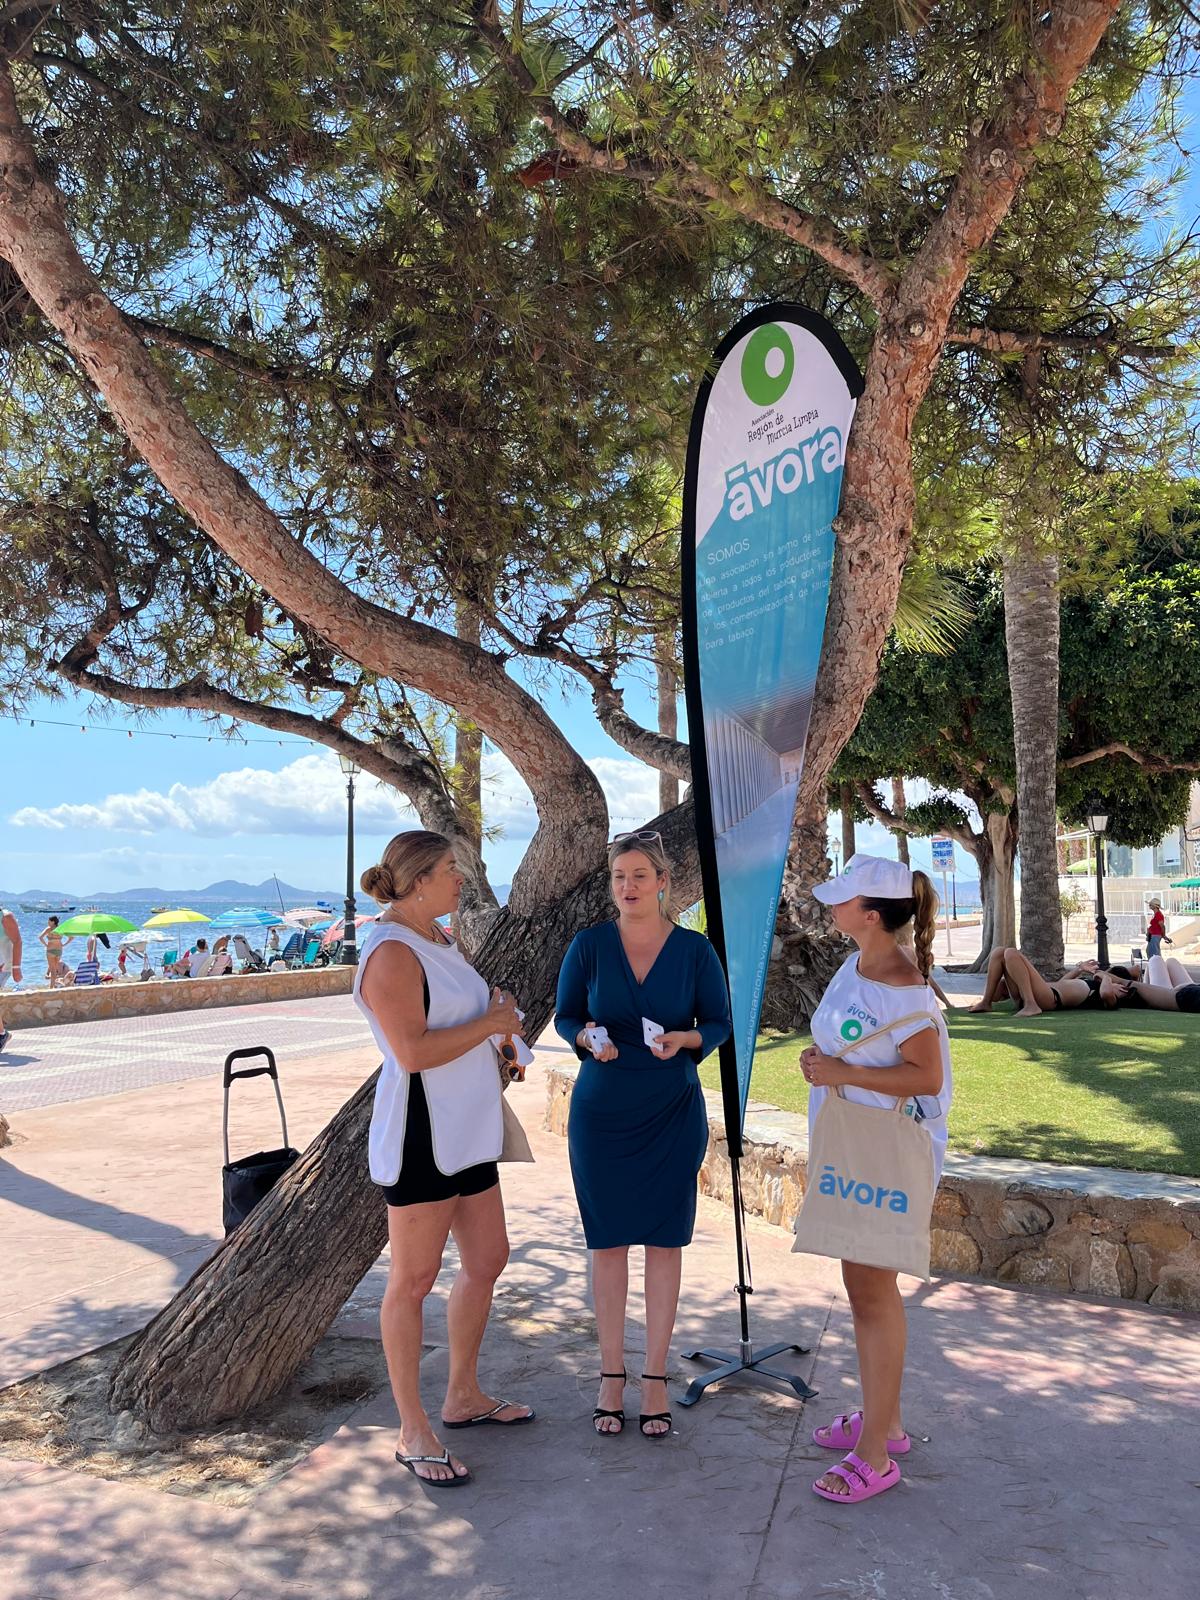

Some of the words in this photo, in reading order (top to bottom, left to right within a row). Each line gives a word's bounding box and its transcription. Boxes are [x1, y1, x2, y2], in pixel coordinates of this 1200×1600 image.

[747, 420, 773, 443] Región
[775, 412, 785, 426] de
[792, 409, 819, 429] Limpia
[802, 533, 812, 543] de
[707, 538, 750, 565] SOMOS
[732, 584, 738, 592] a
[703, 607, 713, 618] de
[717, 593, 755, 615] productos
[705, 637, 724, 650] para
[728, 626, 755, 642] tabaco
